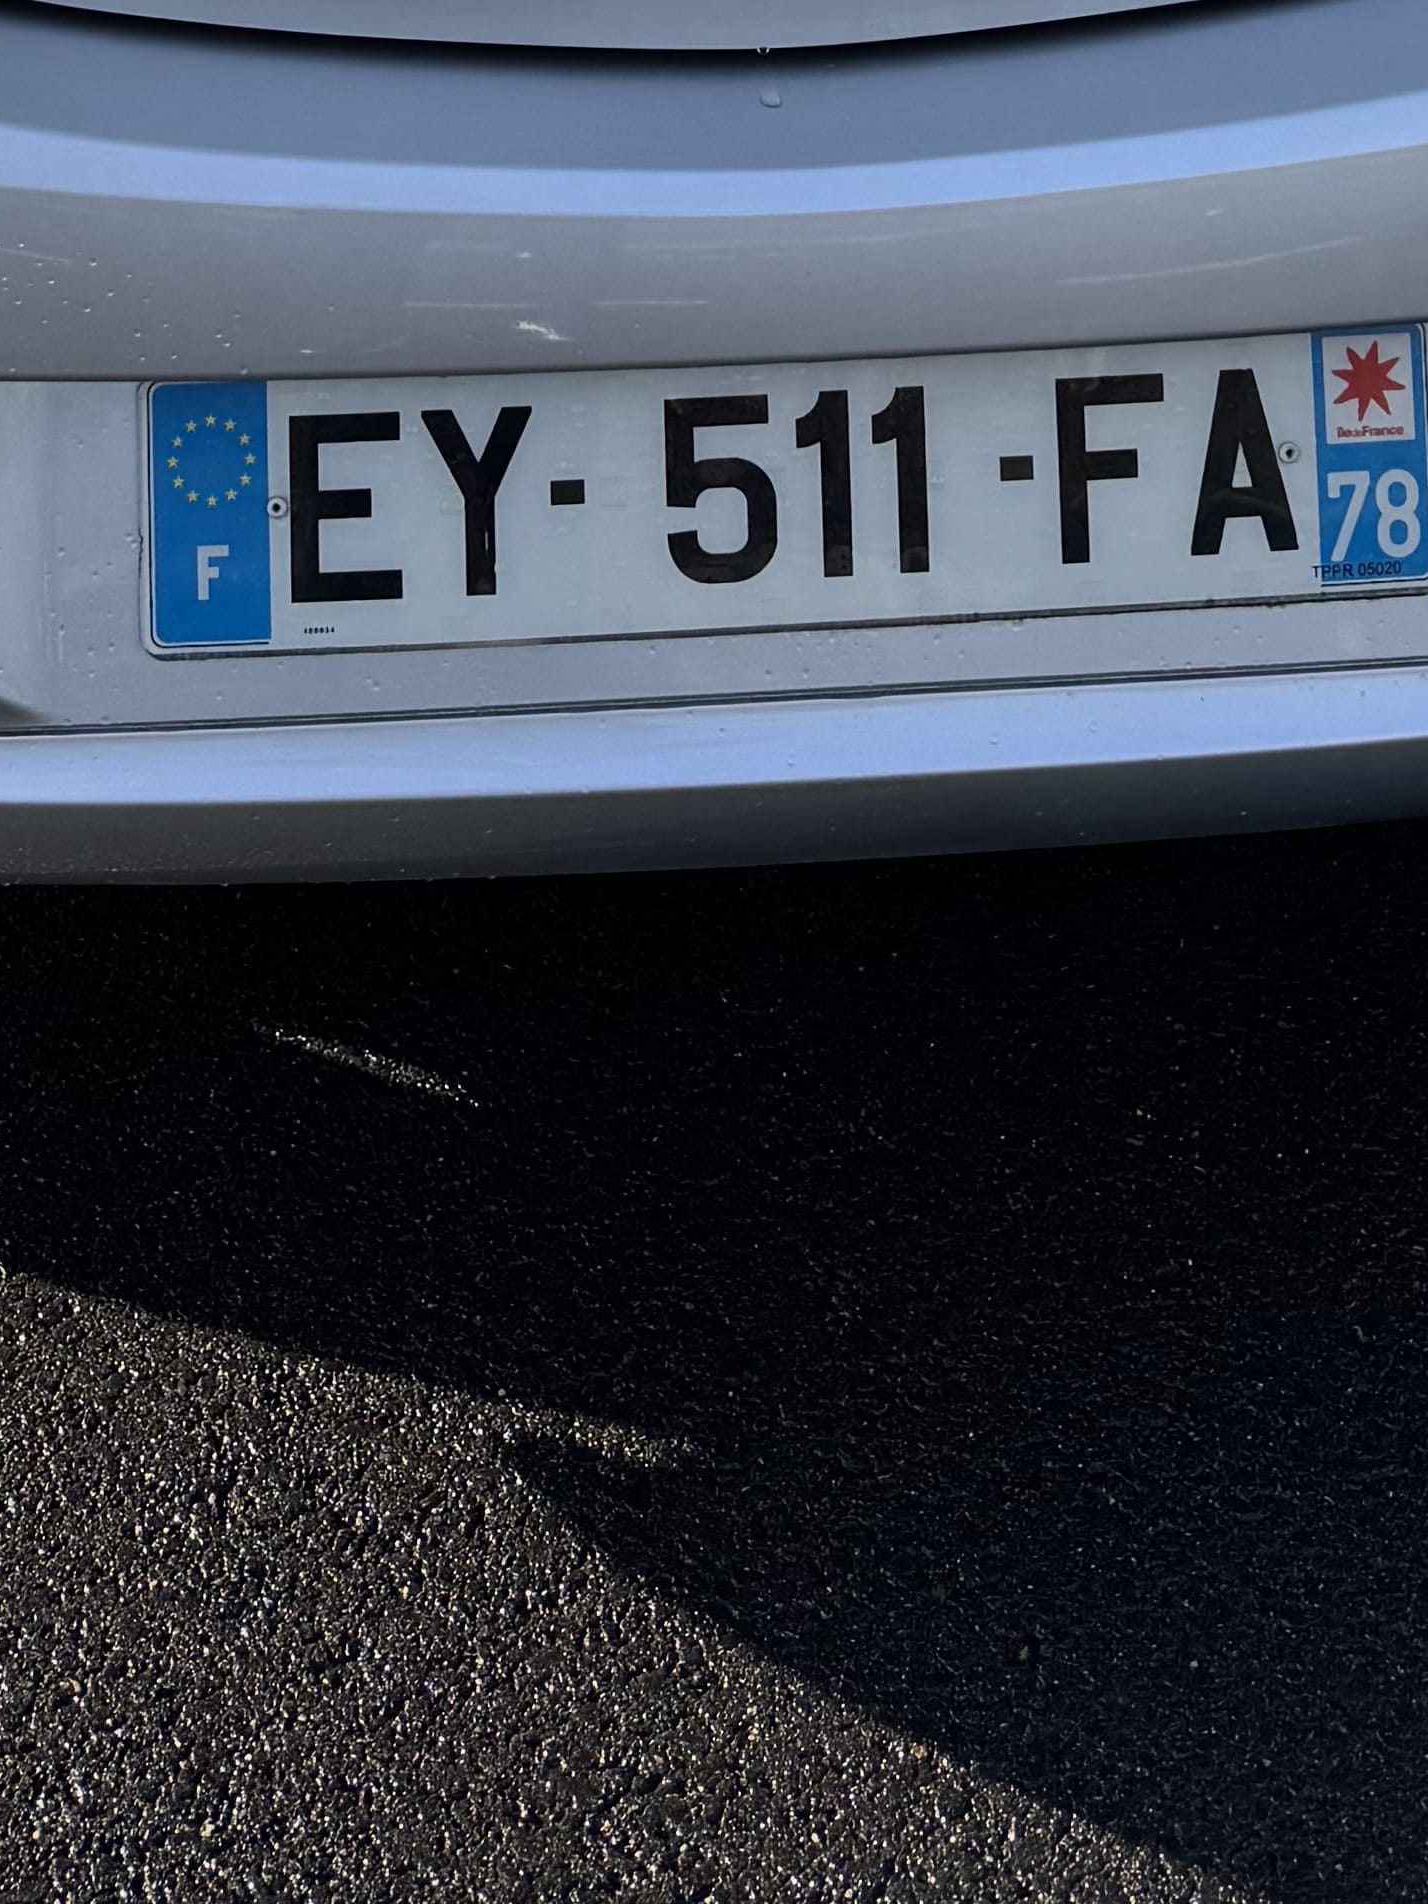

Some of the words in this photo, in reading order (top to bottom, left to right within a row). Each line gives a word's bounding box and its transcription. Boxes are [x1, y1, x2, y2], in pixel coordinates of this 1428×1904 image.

[1327, 468, 1421, 562] 78
[197, 545, 230, 600] F
[1357, 559, 1402, 577] 05020
